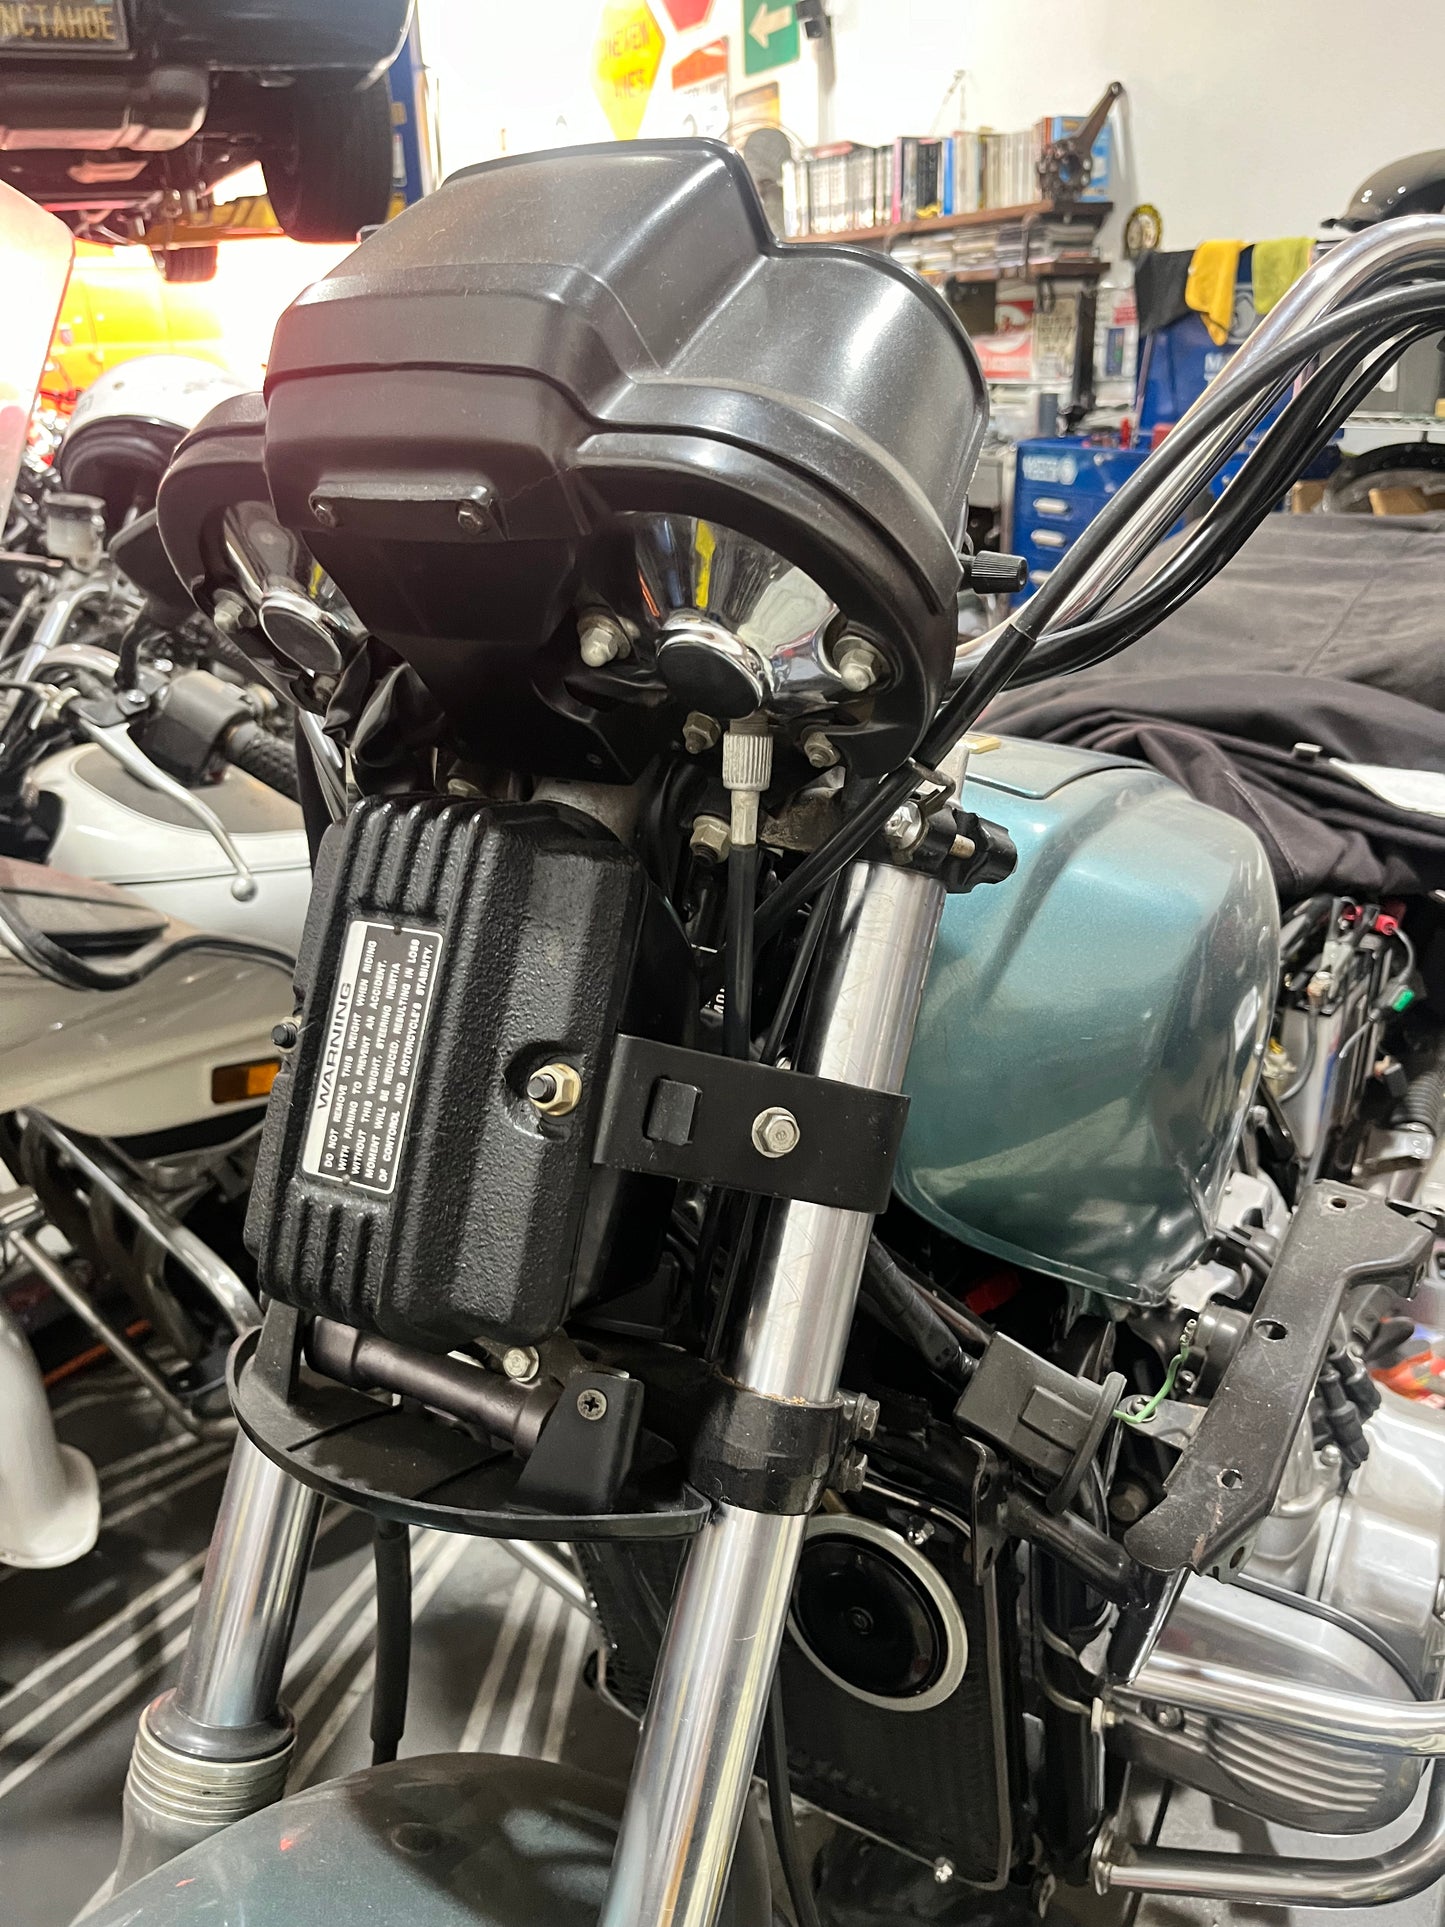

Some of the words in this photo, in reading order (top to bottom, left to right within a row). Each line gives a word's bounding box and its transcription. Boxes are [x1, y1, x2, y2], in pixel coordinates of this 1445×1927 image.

[362, 940, 377, 973] RIDING
[407, 939, 420, 964] LOSS
[385, 963, 401, 1000] INERTIA
[403, 967, 415, 979] IN
[355, 978, 369, 1007] WHEN
[365, 1015, 376, 1030] AN
[392, 983, 411, 1035] RESULTING
[347, 1012, 362, 1050] WEIGHT
[375, 1005, 392, 1050] STEERING
[399, 1002, 422, 1076] MOTORCYCLE'S
[317, 983, 351, 1109] WARNING
[355, 1035, 371, 1076] PREVENT
[341, 1055, 354, 1078] THIS
[366, 1055, 383, 1095] WEIGHT,
[382, 1039, 400, 1085] REDUCED,
[332, 1084, 348, 1123] REMOVE
[351, 1081, 363, 1095] TO
[379, 1089, 390, 1102] BE
[394, 1082, 406, 1104] AND
[343, 1101, 359, 1139] FAIRING
[360, 1100, 373, 1123] THIS
[373, 1106, 387, 1130] WILL
[327, 1128, 339, 1149] NOT
[351, 1129, 367, 1174] WITHOUT
[323, 1152, 335, 1168] DO
[337, 1144, 350, 1171] WITH
[364, 1134, 381, 1179] MOMENT
[378, 1168, 388, 1183] OF
